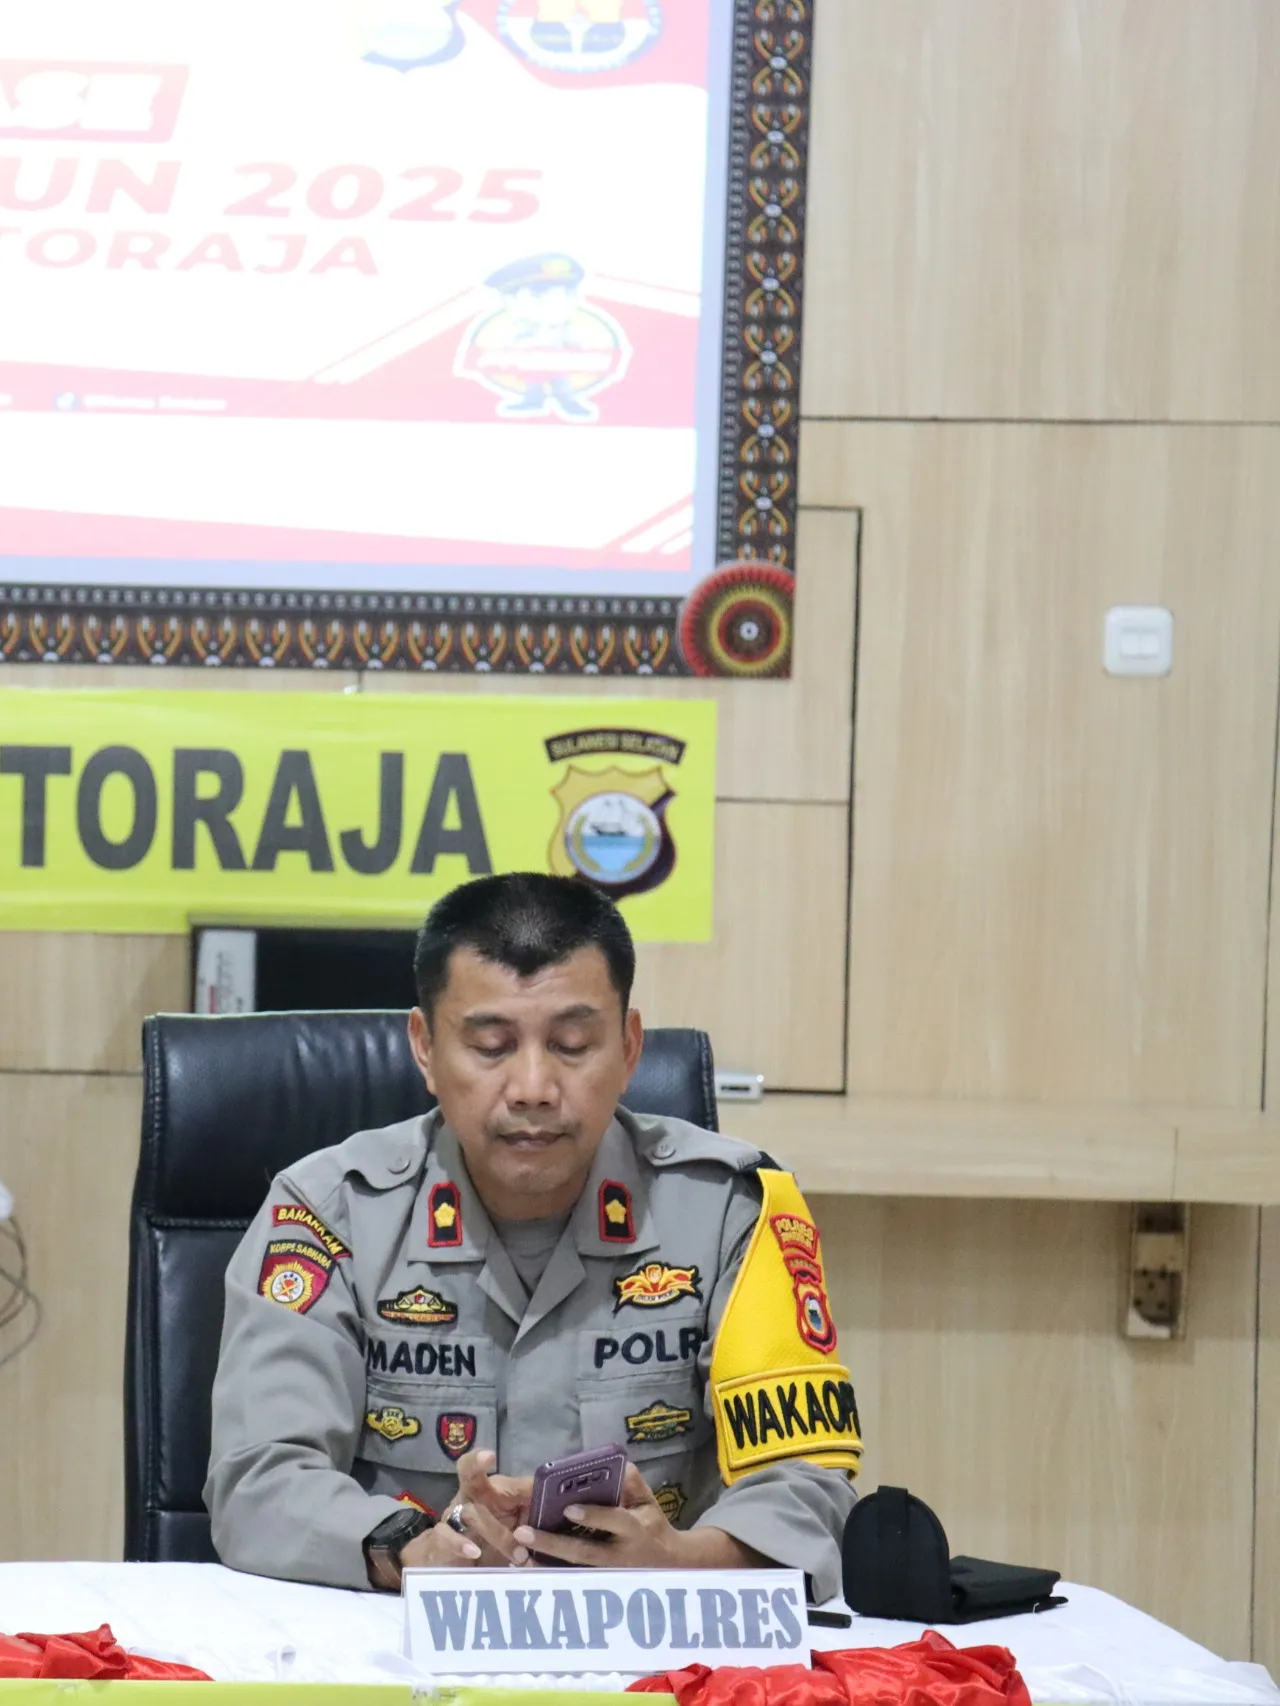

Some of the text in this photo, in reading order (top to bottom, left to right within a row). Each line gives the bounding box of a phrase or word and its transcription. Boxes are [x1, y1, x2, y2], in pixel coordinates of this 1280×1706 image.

[223, 161, 543, 224] 2025
[367, 1340, 476, 1378] MADEN
[723, 1380, 861, 1449] WAKAOP
[419, 1587, 803, 1653] WAKAPOLRES
